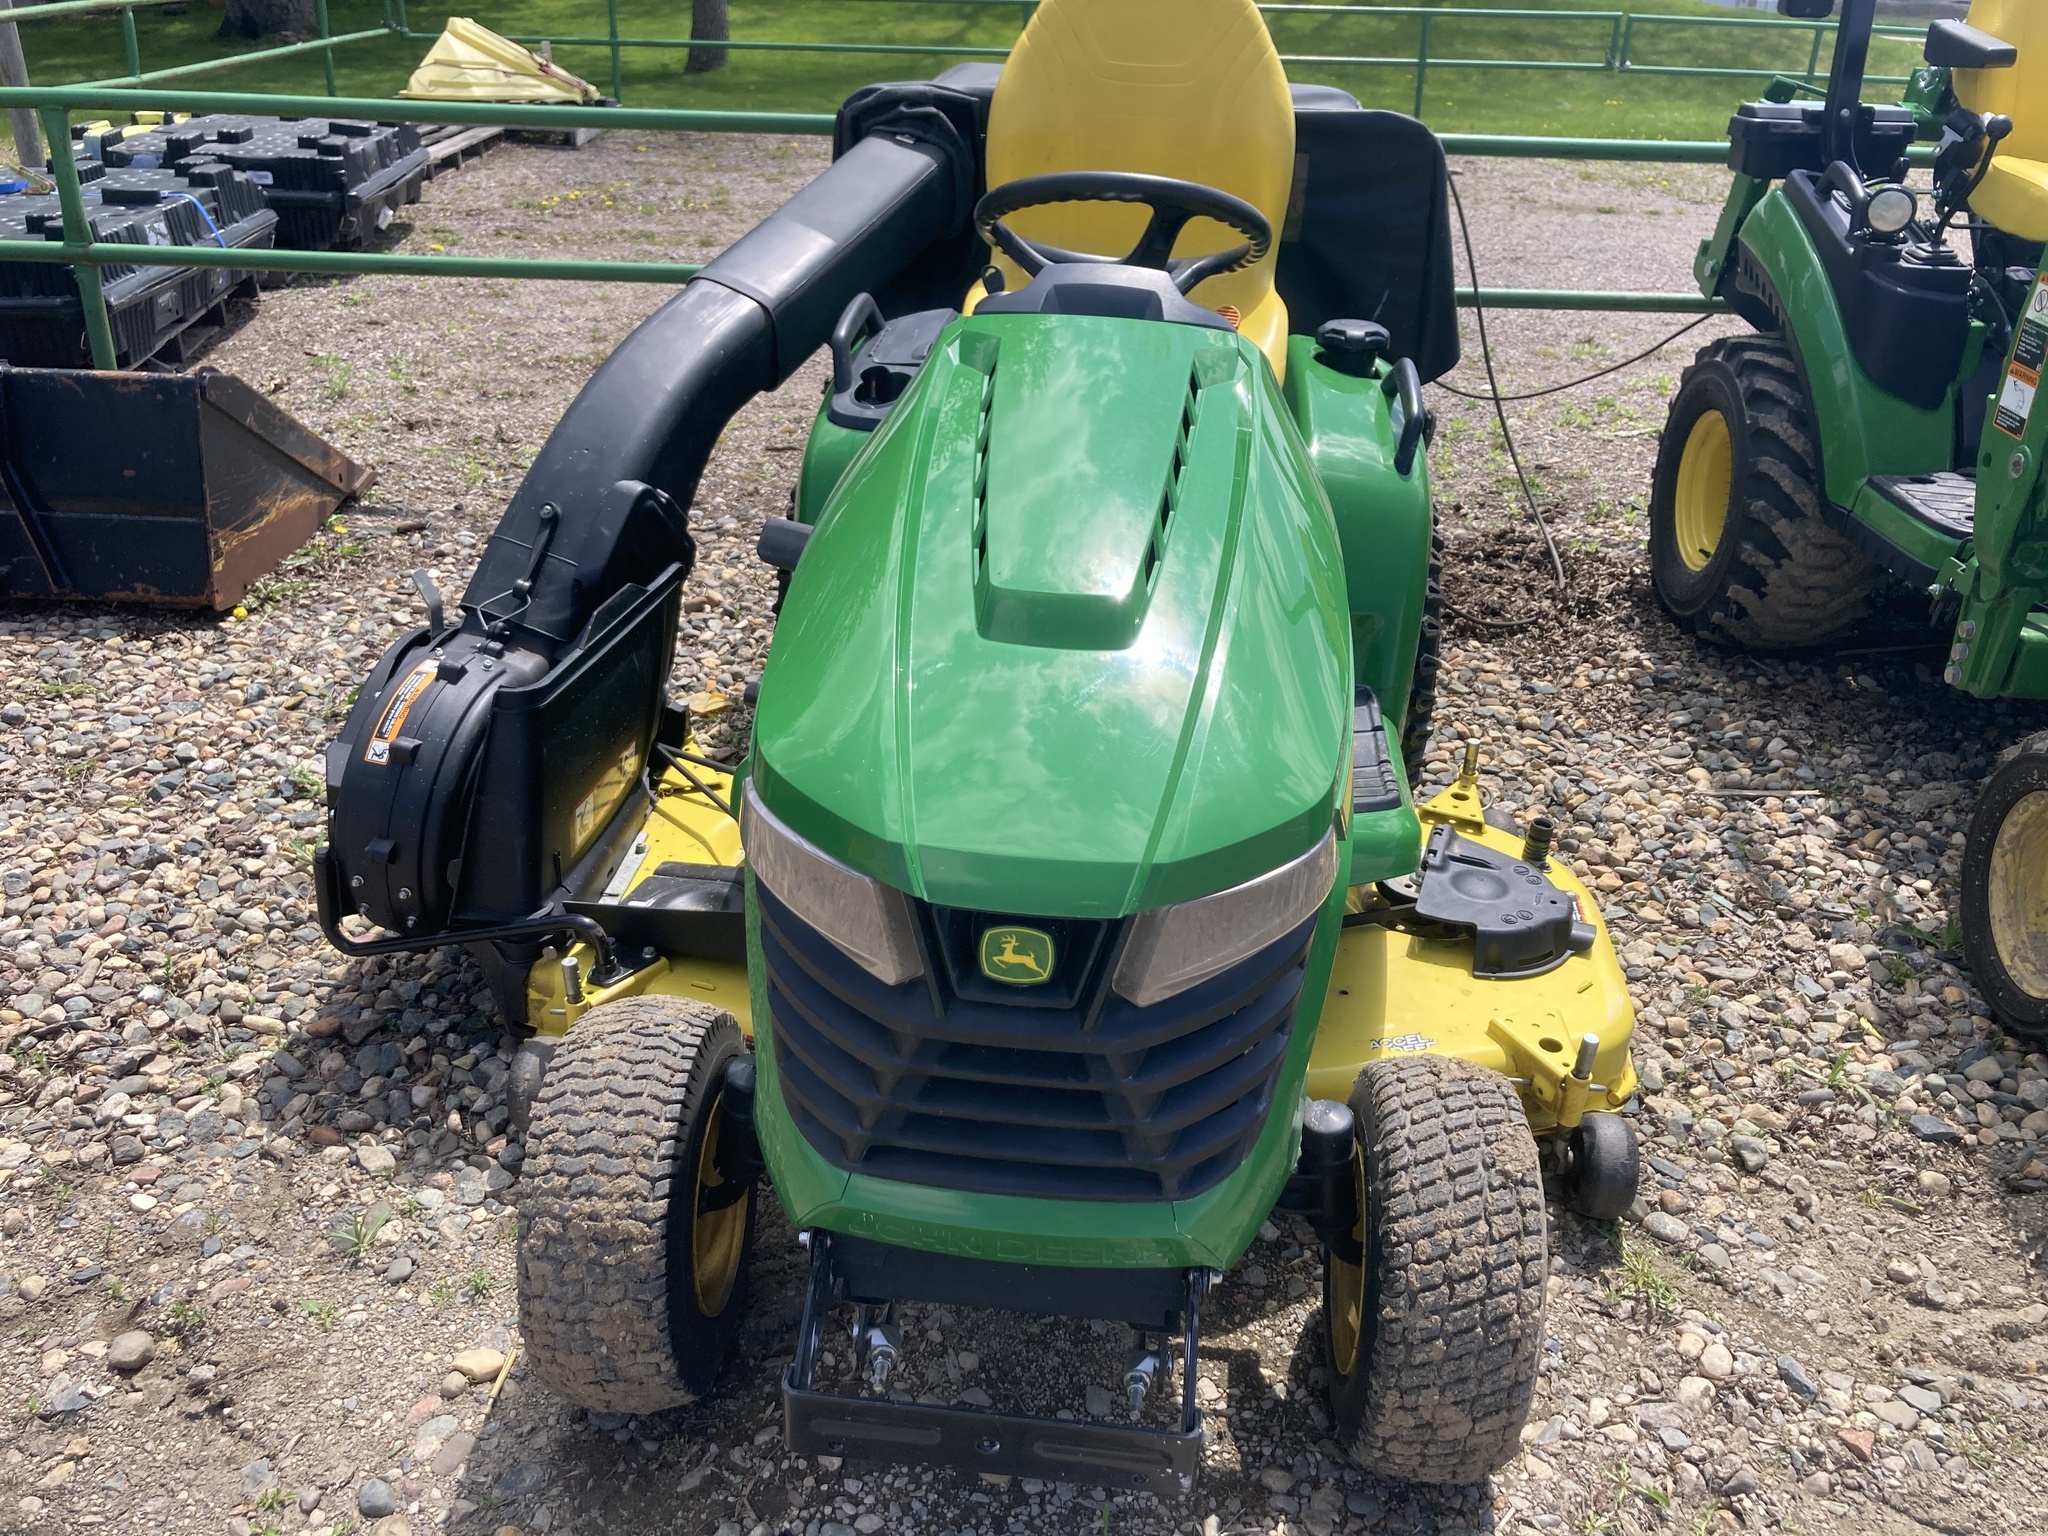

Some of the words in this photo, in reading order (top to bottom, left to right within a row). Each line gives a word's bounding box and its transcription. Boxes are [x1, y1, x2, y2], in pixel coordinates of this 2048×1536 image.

[2014, 367, 2038, 386] WARNING
[1370, 1032, 1430, 1050] ACCEL
[848, 1212, 984, 1255] JOHN
